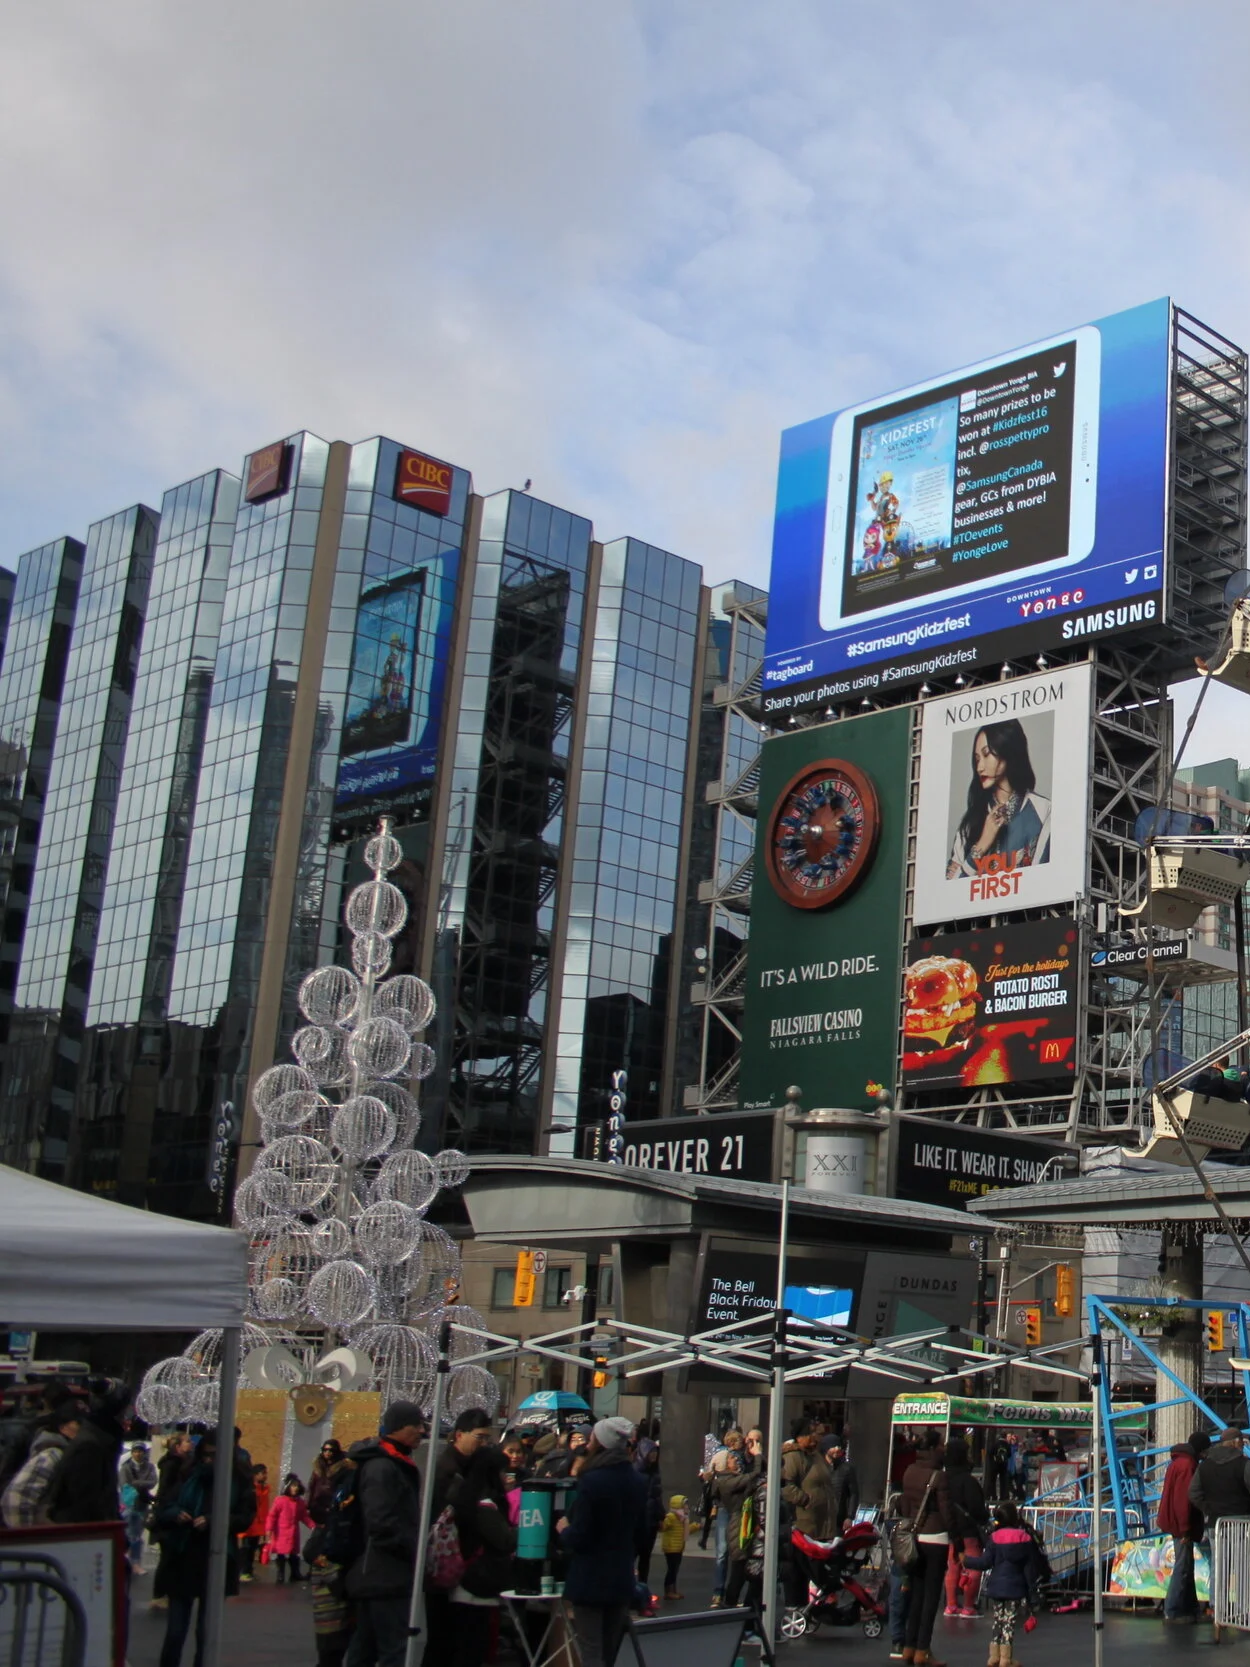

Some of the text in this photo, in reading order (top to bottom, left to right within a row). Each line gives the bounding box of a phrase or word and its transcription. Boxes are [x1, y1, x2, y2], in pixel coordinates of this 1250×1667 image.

[977, 382, 1009, 397] Downtown
[960, 387, 1056, 427] So many prizes to be
[880, 416, 937, 446] KIDZFEST
[959, 406, 1048, 444] won at #Kidzfest16
[958, 446, 977, 460] incl.
[979, 424, 1050, 455] @rosspettypro
[251, 450, 277, 470] CIBC
[406, 457, 450, 488] CIBC
[957, 466, 971, 477] tix,
[956, 459, 1043, 495] @SamsungCanada
[955, 472, 1057, 514] gear, GCs from DYBIA
[954, 490, 1047, 528] businesses & more!
[953, 523, 1003, 545] #TOevents
[952, 539, 1009, 563] #YongeLove
[1007, 587, 1052, 603] DOWNTOWN
[1021, 590, 1084, 617] Yonge
[1062, 600, 1156, 639] SAMSUNG
[847, 612, 971, 657] #SamsungKidzfest
[764, 647, 977, 712] Share your photos using #SamsungKidzfest
[766, 660, 814, 681] #tagboard
[945, 681, 1064, 726] NORDSTROM
[974, 851, 1017, 877] YOU
[970, 872, 1023, 901] FIRST
[1107, 950, 1136, 963] Clear
[761, 955, 879, 987] IT'S A WILD RIDE.
[985, 959, 1069, 982] Just for the holidays
[994, 974, 1059, 996] POTATO ROSTI
[985, 990, 1067, 1014] & BACON BURGER
[770, 1008, 862, 1037] FALLSVIEW CASINO
[770, 1030, 861, 1049] NIAGARA FALLS
[624, 1135, 744, 1174] OREVER 21
[813, 1154, 857, 1171] XXI
[914, 1143, 942, 1169] LIKE
[945, 1149, 957, 1171] IT.
[961, 1151, 995, 1177] WEAR
[999, 1156, 1010, 1179] IT.
[1013, 1159, 1051, 1183] SHARE
[712, 1278, 755, 1293] The Bell
[900, 1277, 957, 1292] DUNDAS
[706, 1307, 740, 1321] Event.
[709, 1293, 777, 1312] Black Friday
[874, 1301, 888, 1337] NGE
[908, 1350, 945, 1363] UARE
[893, 1402, 947, 1415] ENTRANCE
[986, 1402, 1095, 1423] Ferris Whe
